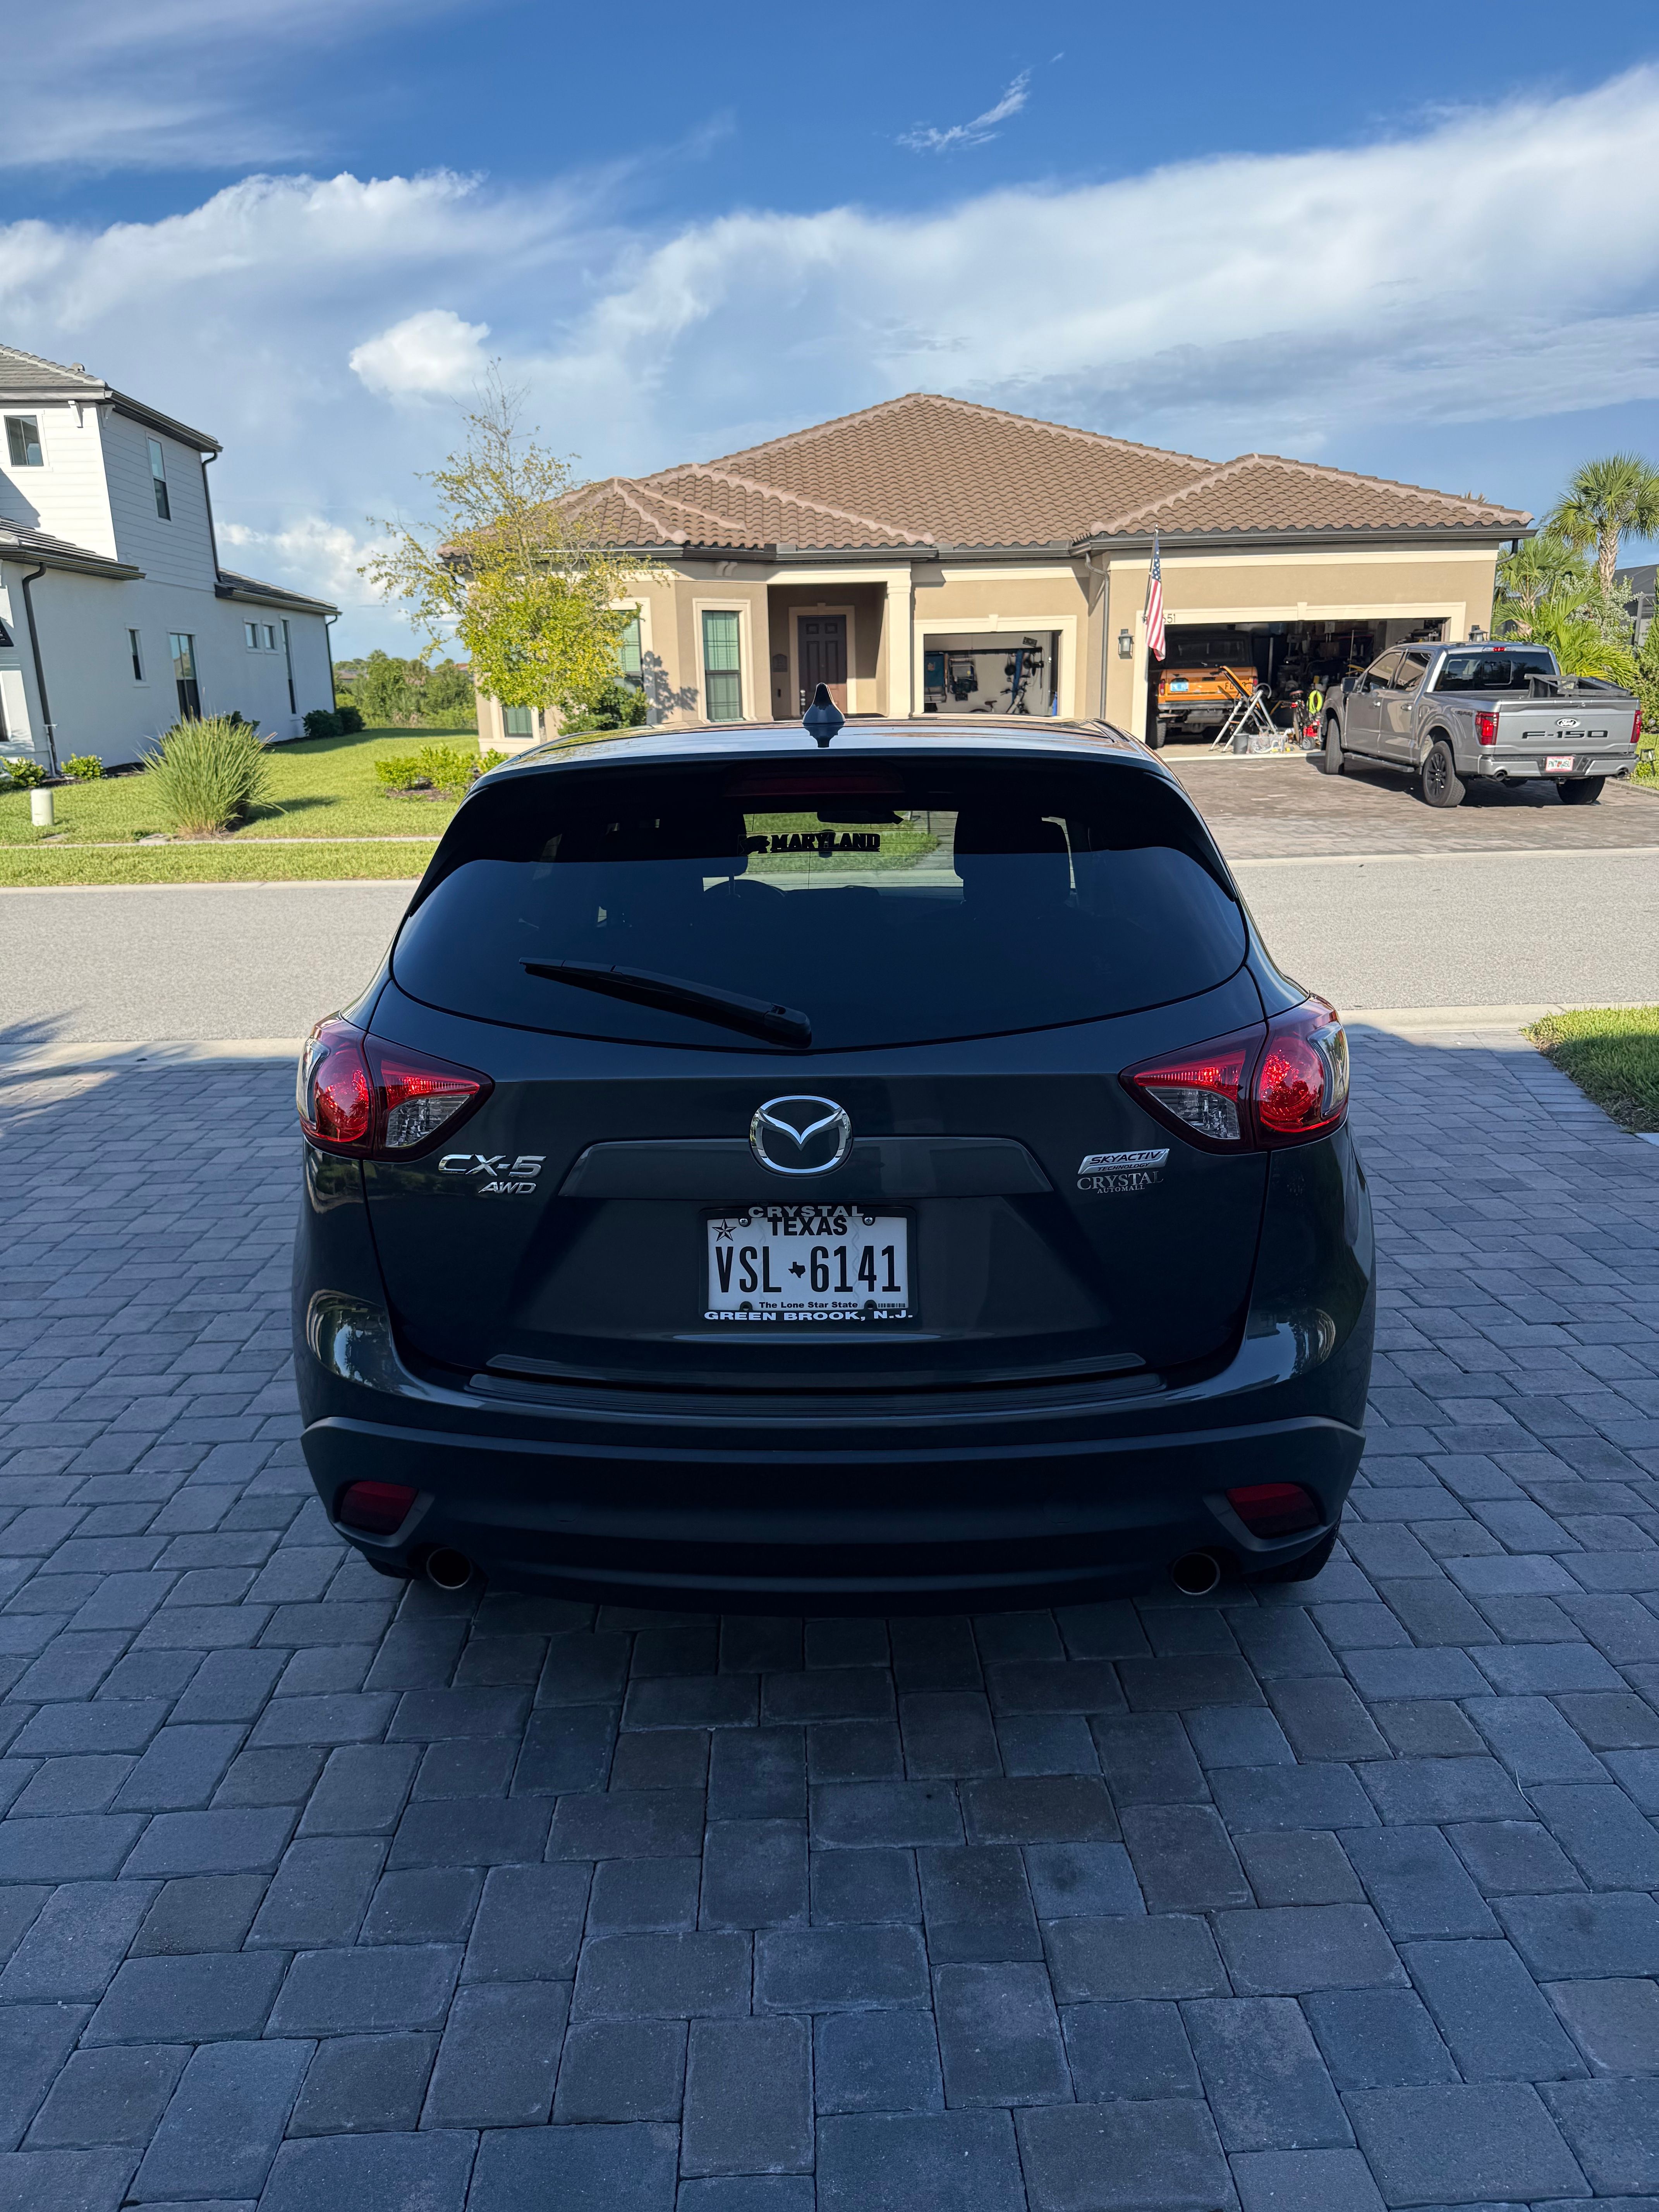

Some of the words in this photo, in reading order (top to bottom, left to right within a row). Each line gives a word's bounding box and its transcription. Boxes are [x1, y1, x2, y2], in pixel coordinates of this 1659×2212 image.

[1522, 730, 1608, 739] F-150
[771, 833, 881, 852] MARYLAND
[1089, 1151, 1161, 1164] SKYACTIV
[438, 1154, 547, 1178] CX-5
[1097, 1163, 1151, 1171] TECHNOLOGY
[478, 1182, 536, 1194] AWD
[1097, 1185, 1145, 1194] AUTOMALL
[748, 1206, 864, 1218] CRYSTAL
[767, 1217, 848, 1236] TEXAS
[715, 1246, 782, 1293] VSL
[810, 1245, 901, 1292] 6141
[704, 1311, 776, 1321] GREEN
[784, 1311, 865, 1321] BROOK,
[874, 1310, 913, 1319] N.J.
